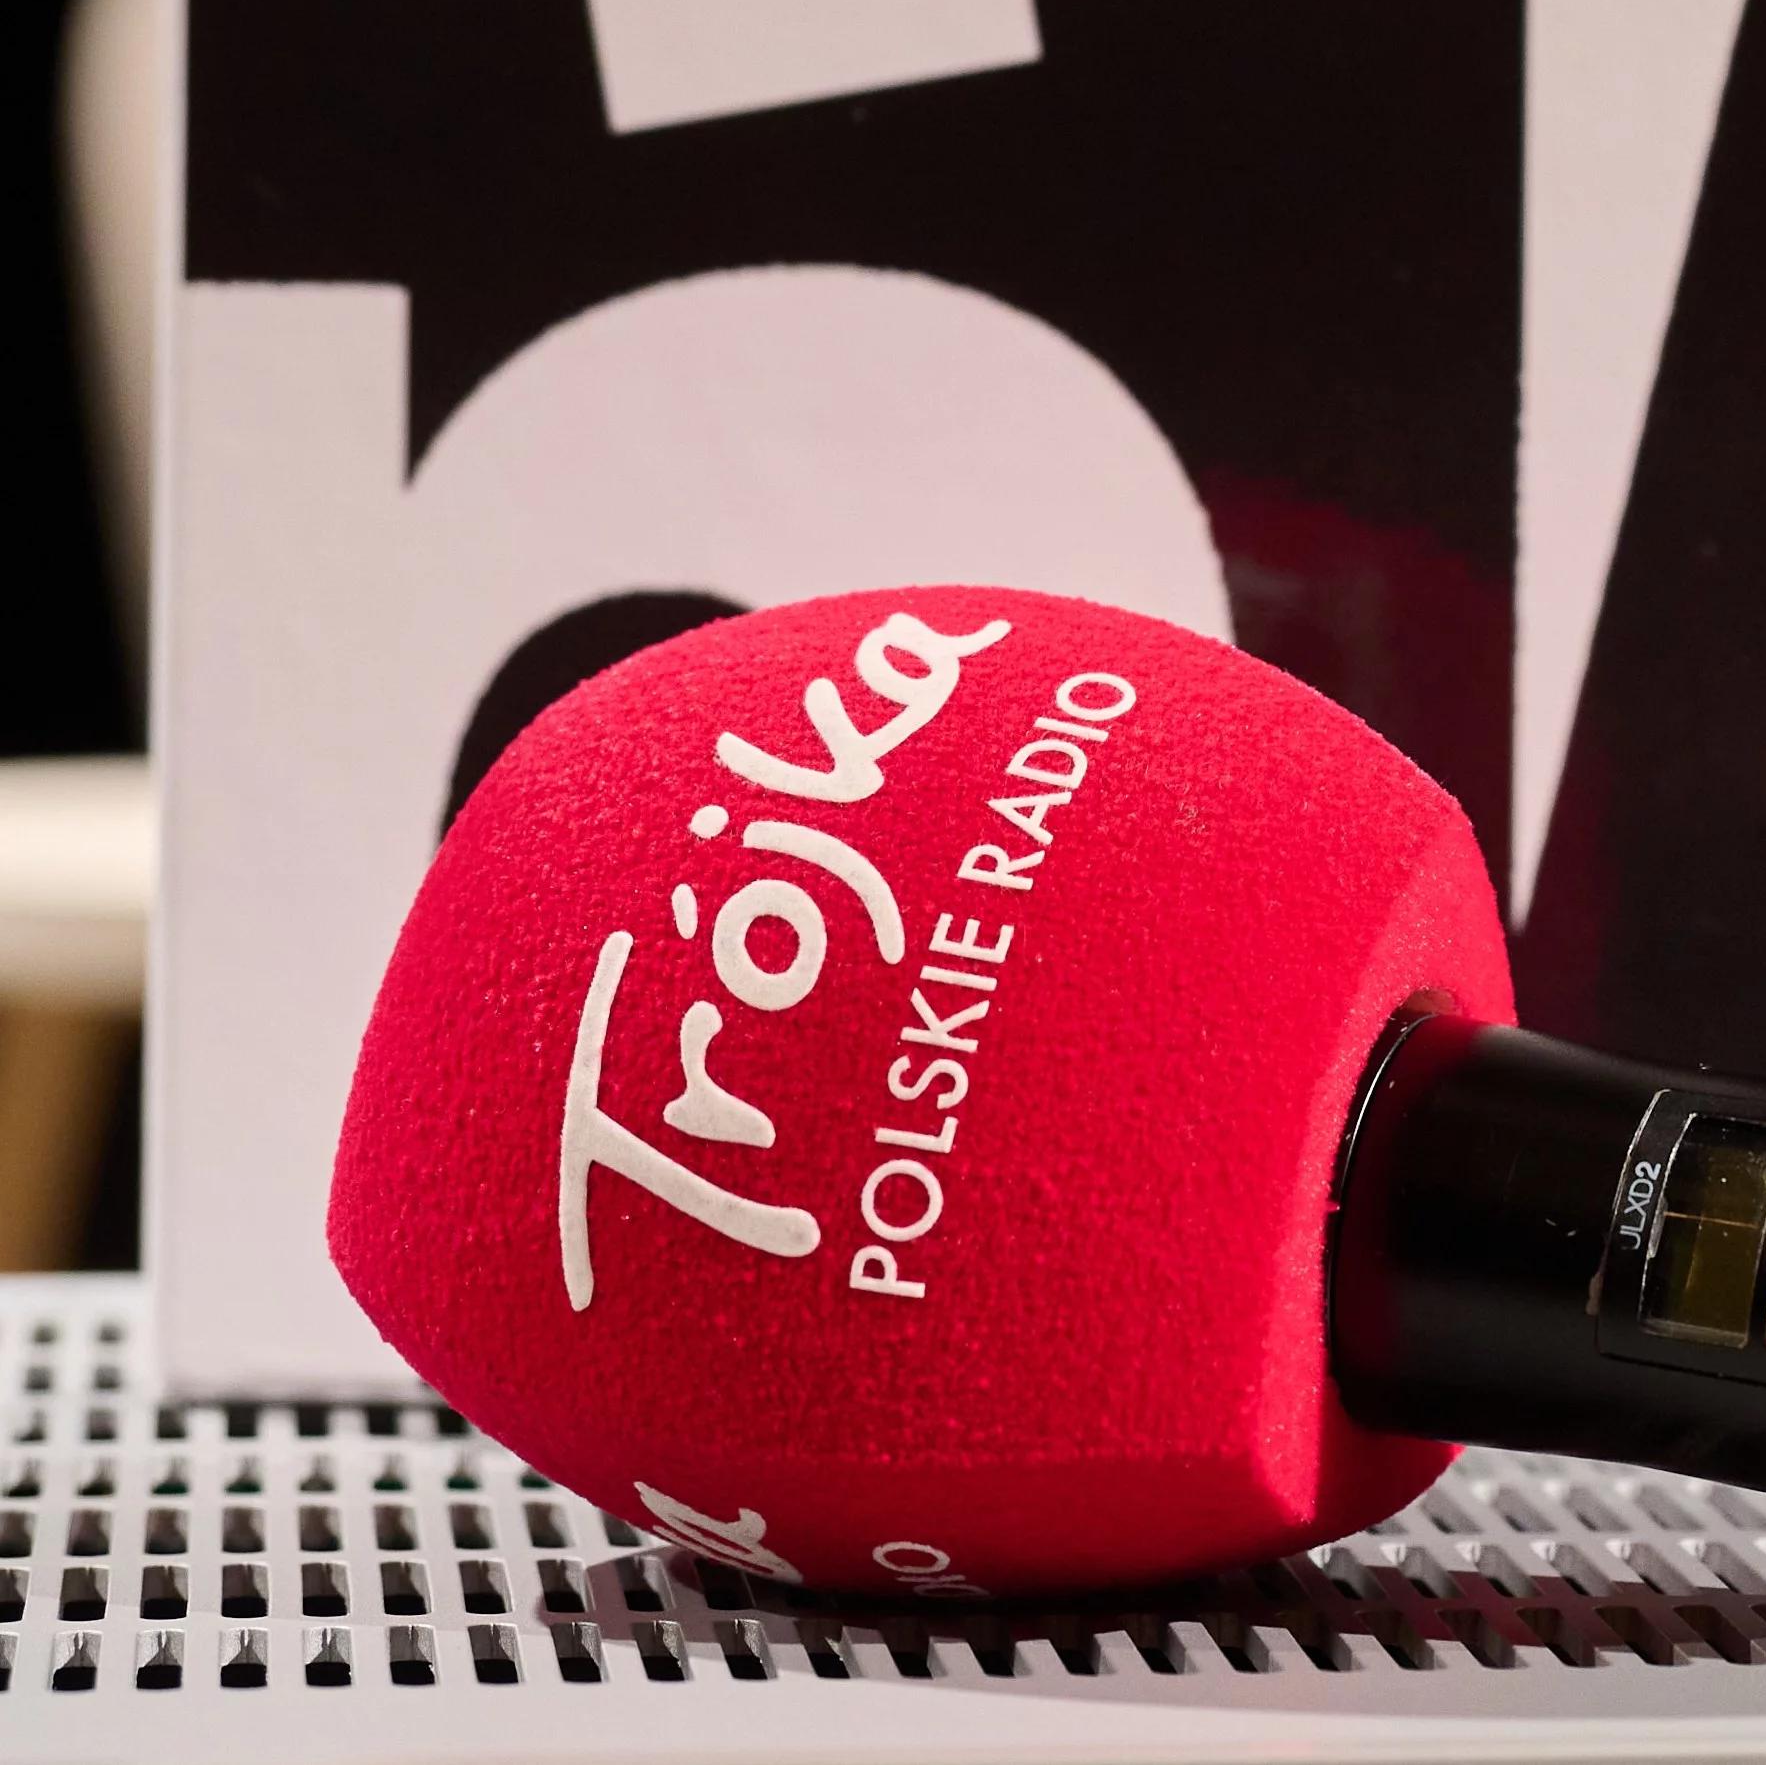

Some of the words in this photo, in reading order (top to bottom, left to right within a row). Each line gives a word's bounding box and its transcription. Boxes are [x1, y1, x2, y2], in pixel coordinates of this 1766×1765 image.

[559, 613, 1011, 1311] Trójka
[850, 913, 1015, 1299] POLSKIE
[957, 672, 1137, 891] RADIO
